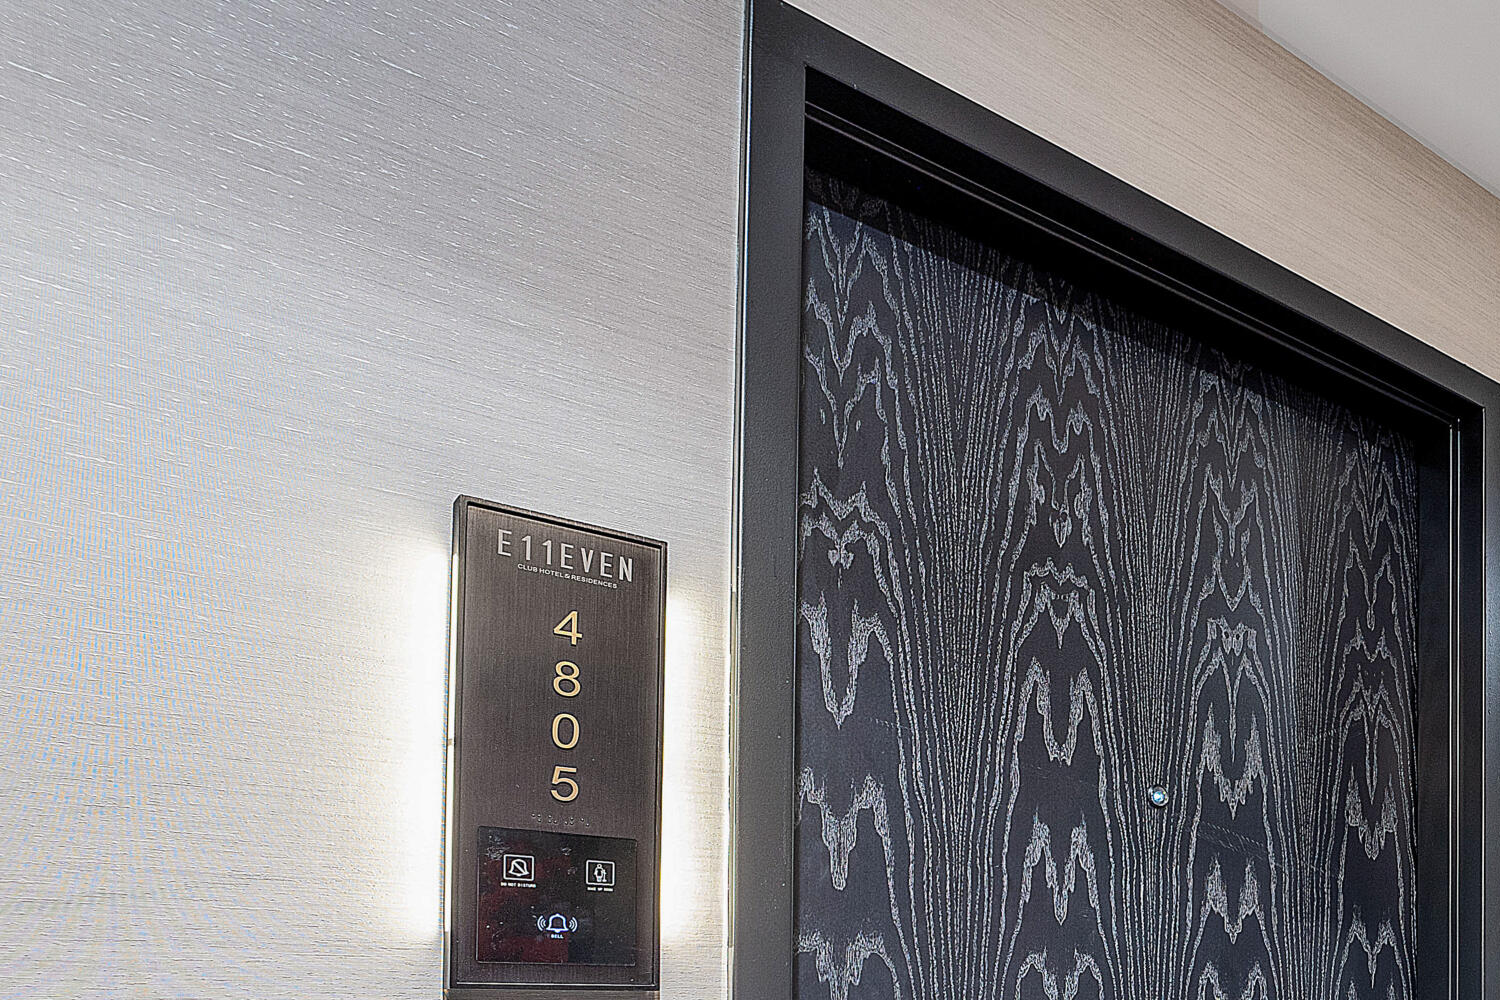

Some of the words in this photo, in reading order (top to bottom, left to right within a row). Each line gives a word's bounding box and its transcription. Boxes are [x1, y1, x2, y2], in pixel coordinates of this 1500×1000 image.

[497, 528, 633, 583] E11EVEN
[517, 563, 538, 573] CLUB
[539, 567, 564, 578] HOTEL
[571, 574, 618, 589] RESIDENCES
[550, 610, 583, 802] 4805
